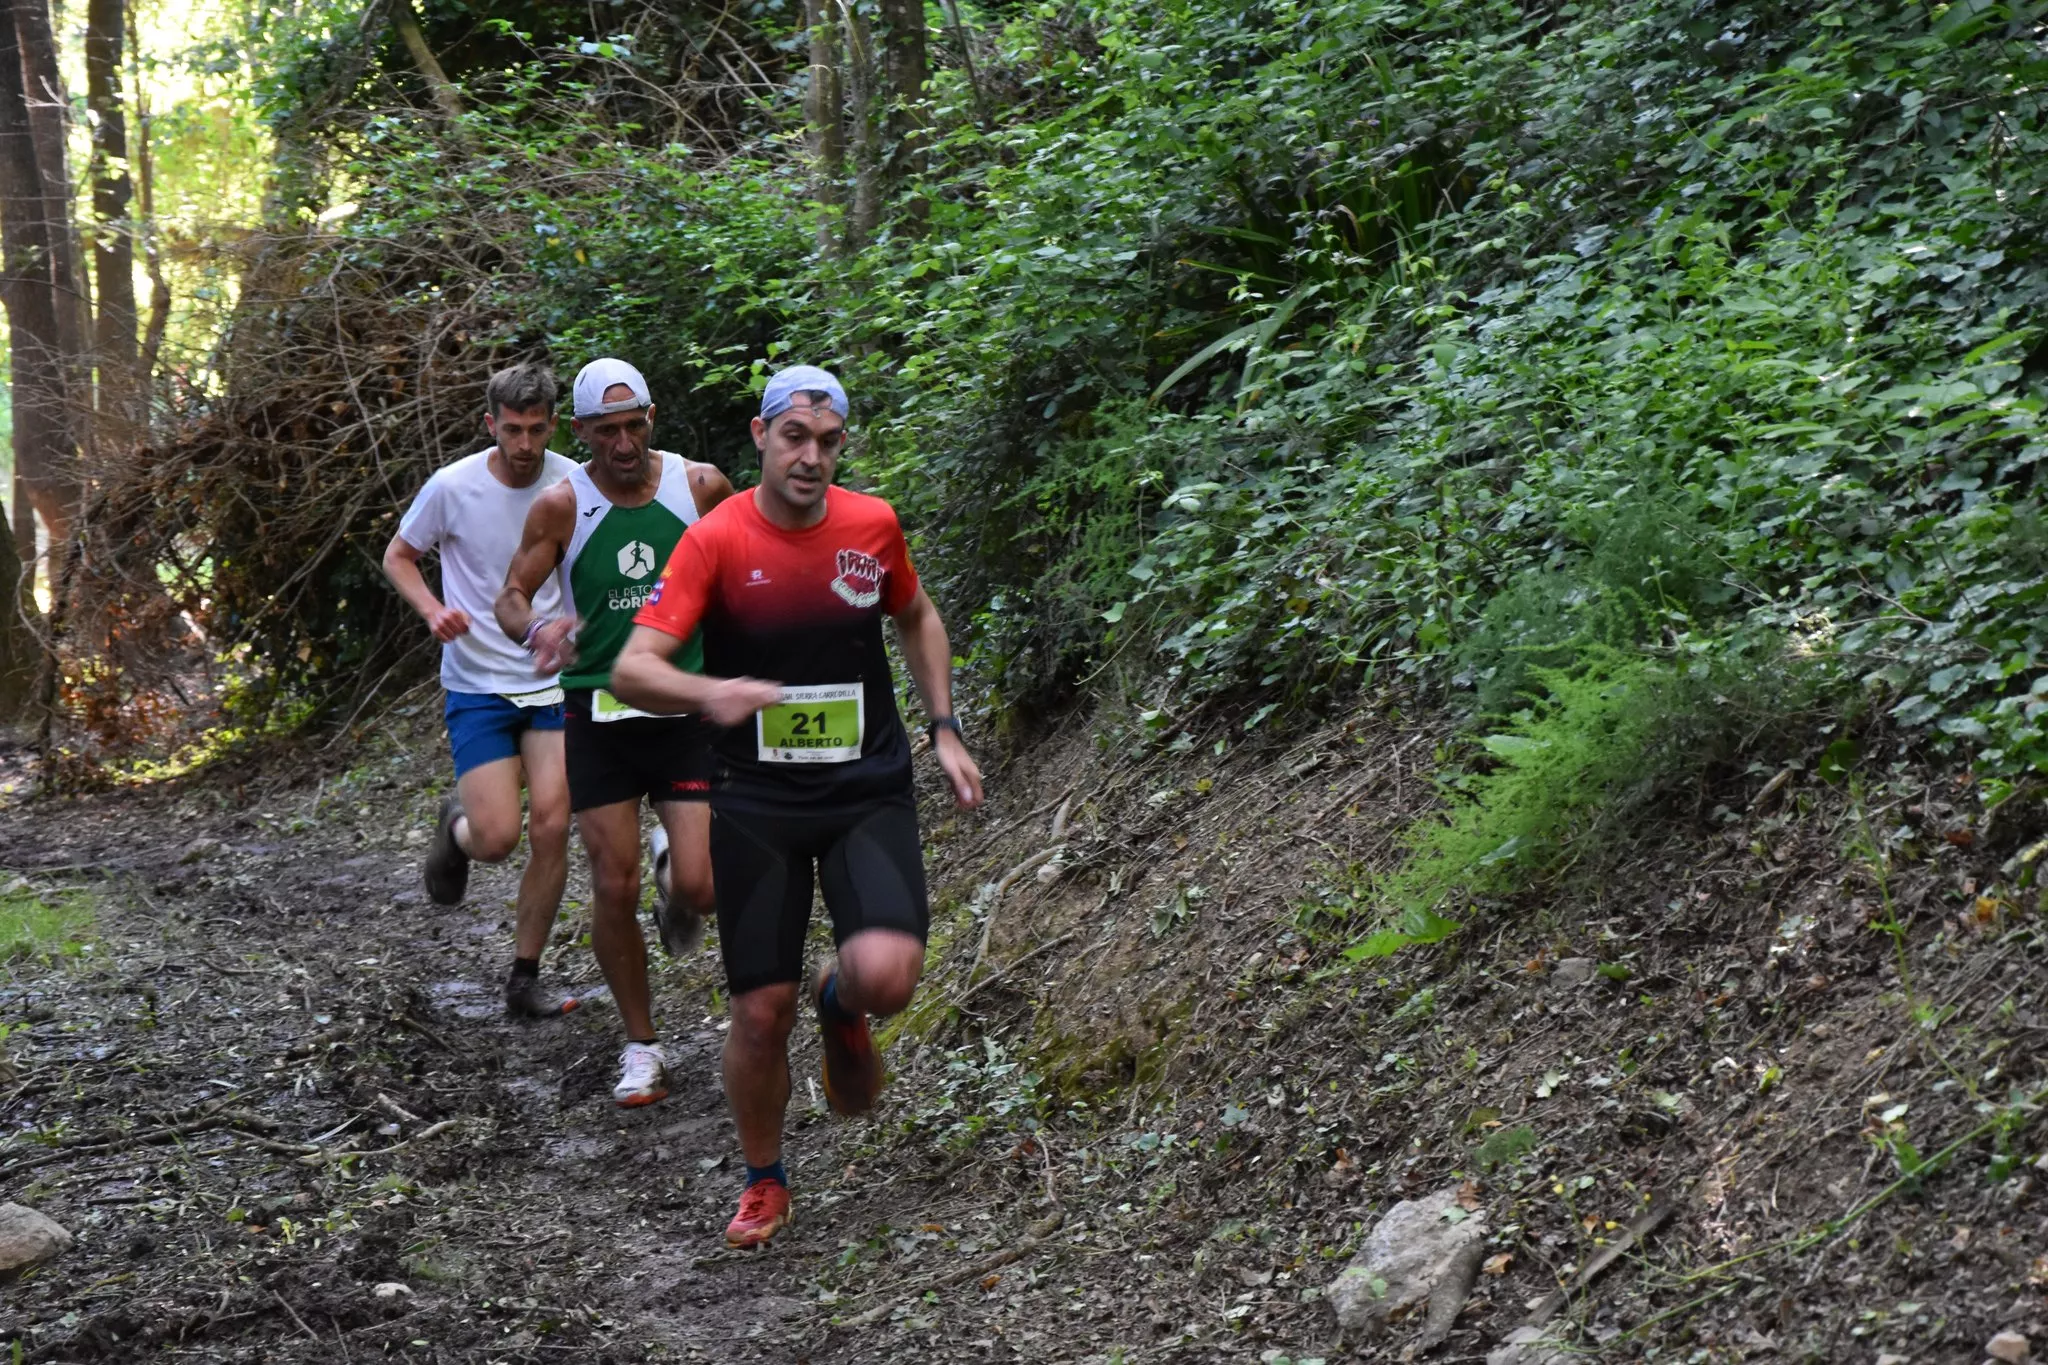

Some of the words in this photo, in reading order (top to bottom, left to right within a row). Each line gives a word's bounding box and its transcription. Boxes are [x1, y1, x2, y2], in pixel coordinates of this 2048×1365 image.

[608, 589, 621, 599] EL
[624, 584, 653, 598] RETO
[791, 711, 827, 735] 21
[779, 737, 843, 748] ALBERTO
